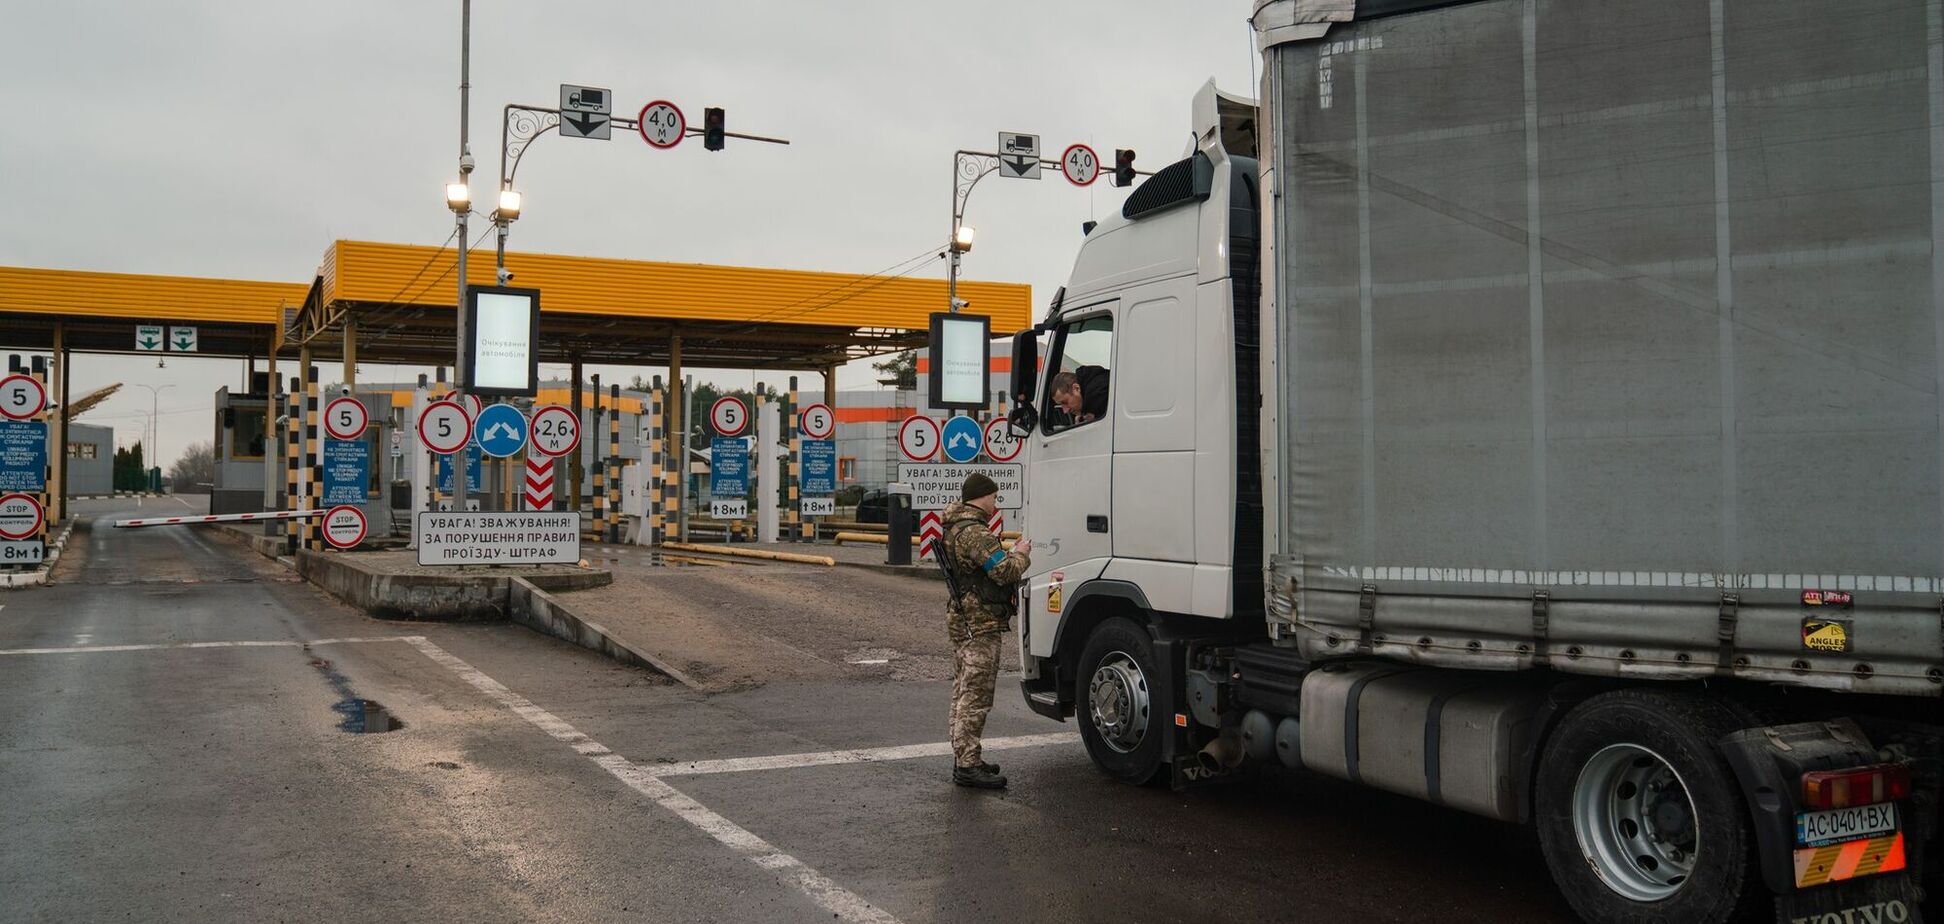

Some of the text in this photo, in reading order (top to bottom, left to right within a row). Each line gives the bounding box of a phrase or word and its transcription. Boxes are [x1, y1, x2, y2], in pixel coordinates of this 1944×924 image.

[649, 110, 676, 128] 4,0
[1070, 153, 1092, 168] 4,0
[13, 388, 27, 406] 5
[340, 411, 352, 427] 5
[725, 409, 735, 424] 5
[814, 415, 824, 429] 5
[438, 417, 451, 437] 5
[542, 420, 567, 438] 2,6
[914, 430, 925, 447] 5
[993, 429, 1013, 445] 2,6
[906, 468, 942, 478] УВАГА!
[6, 505, 28, 513] STOP
[335, 515, 354, 523] STOP
[430, 518, 571, 528] УВАГА! ЗВАЖУВАННЯ!
[425, 533, 576, 544] ЗА ПОРУШЕННЯ ПРАВИЛ
[509, 548, 557, 558] ШТРАФ
[1046, 538, 1061, 556] 5
[1809, 637, 1846, 645] ANGLES
